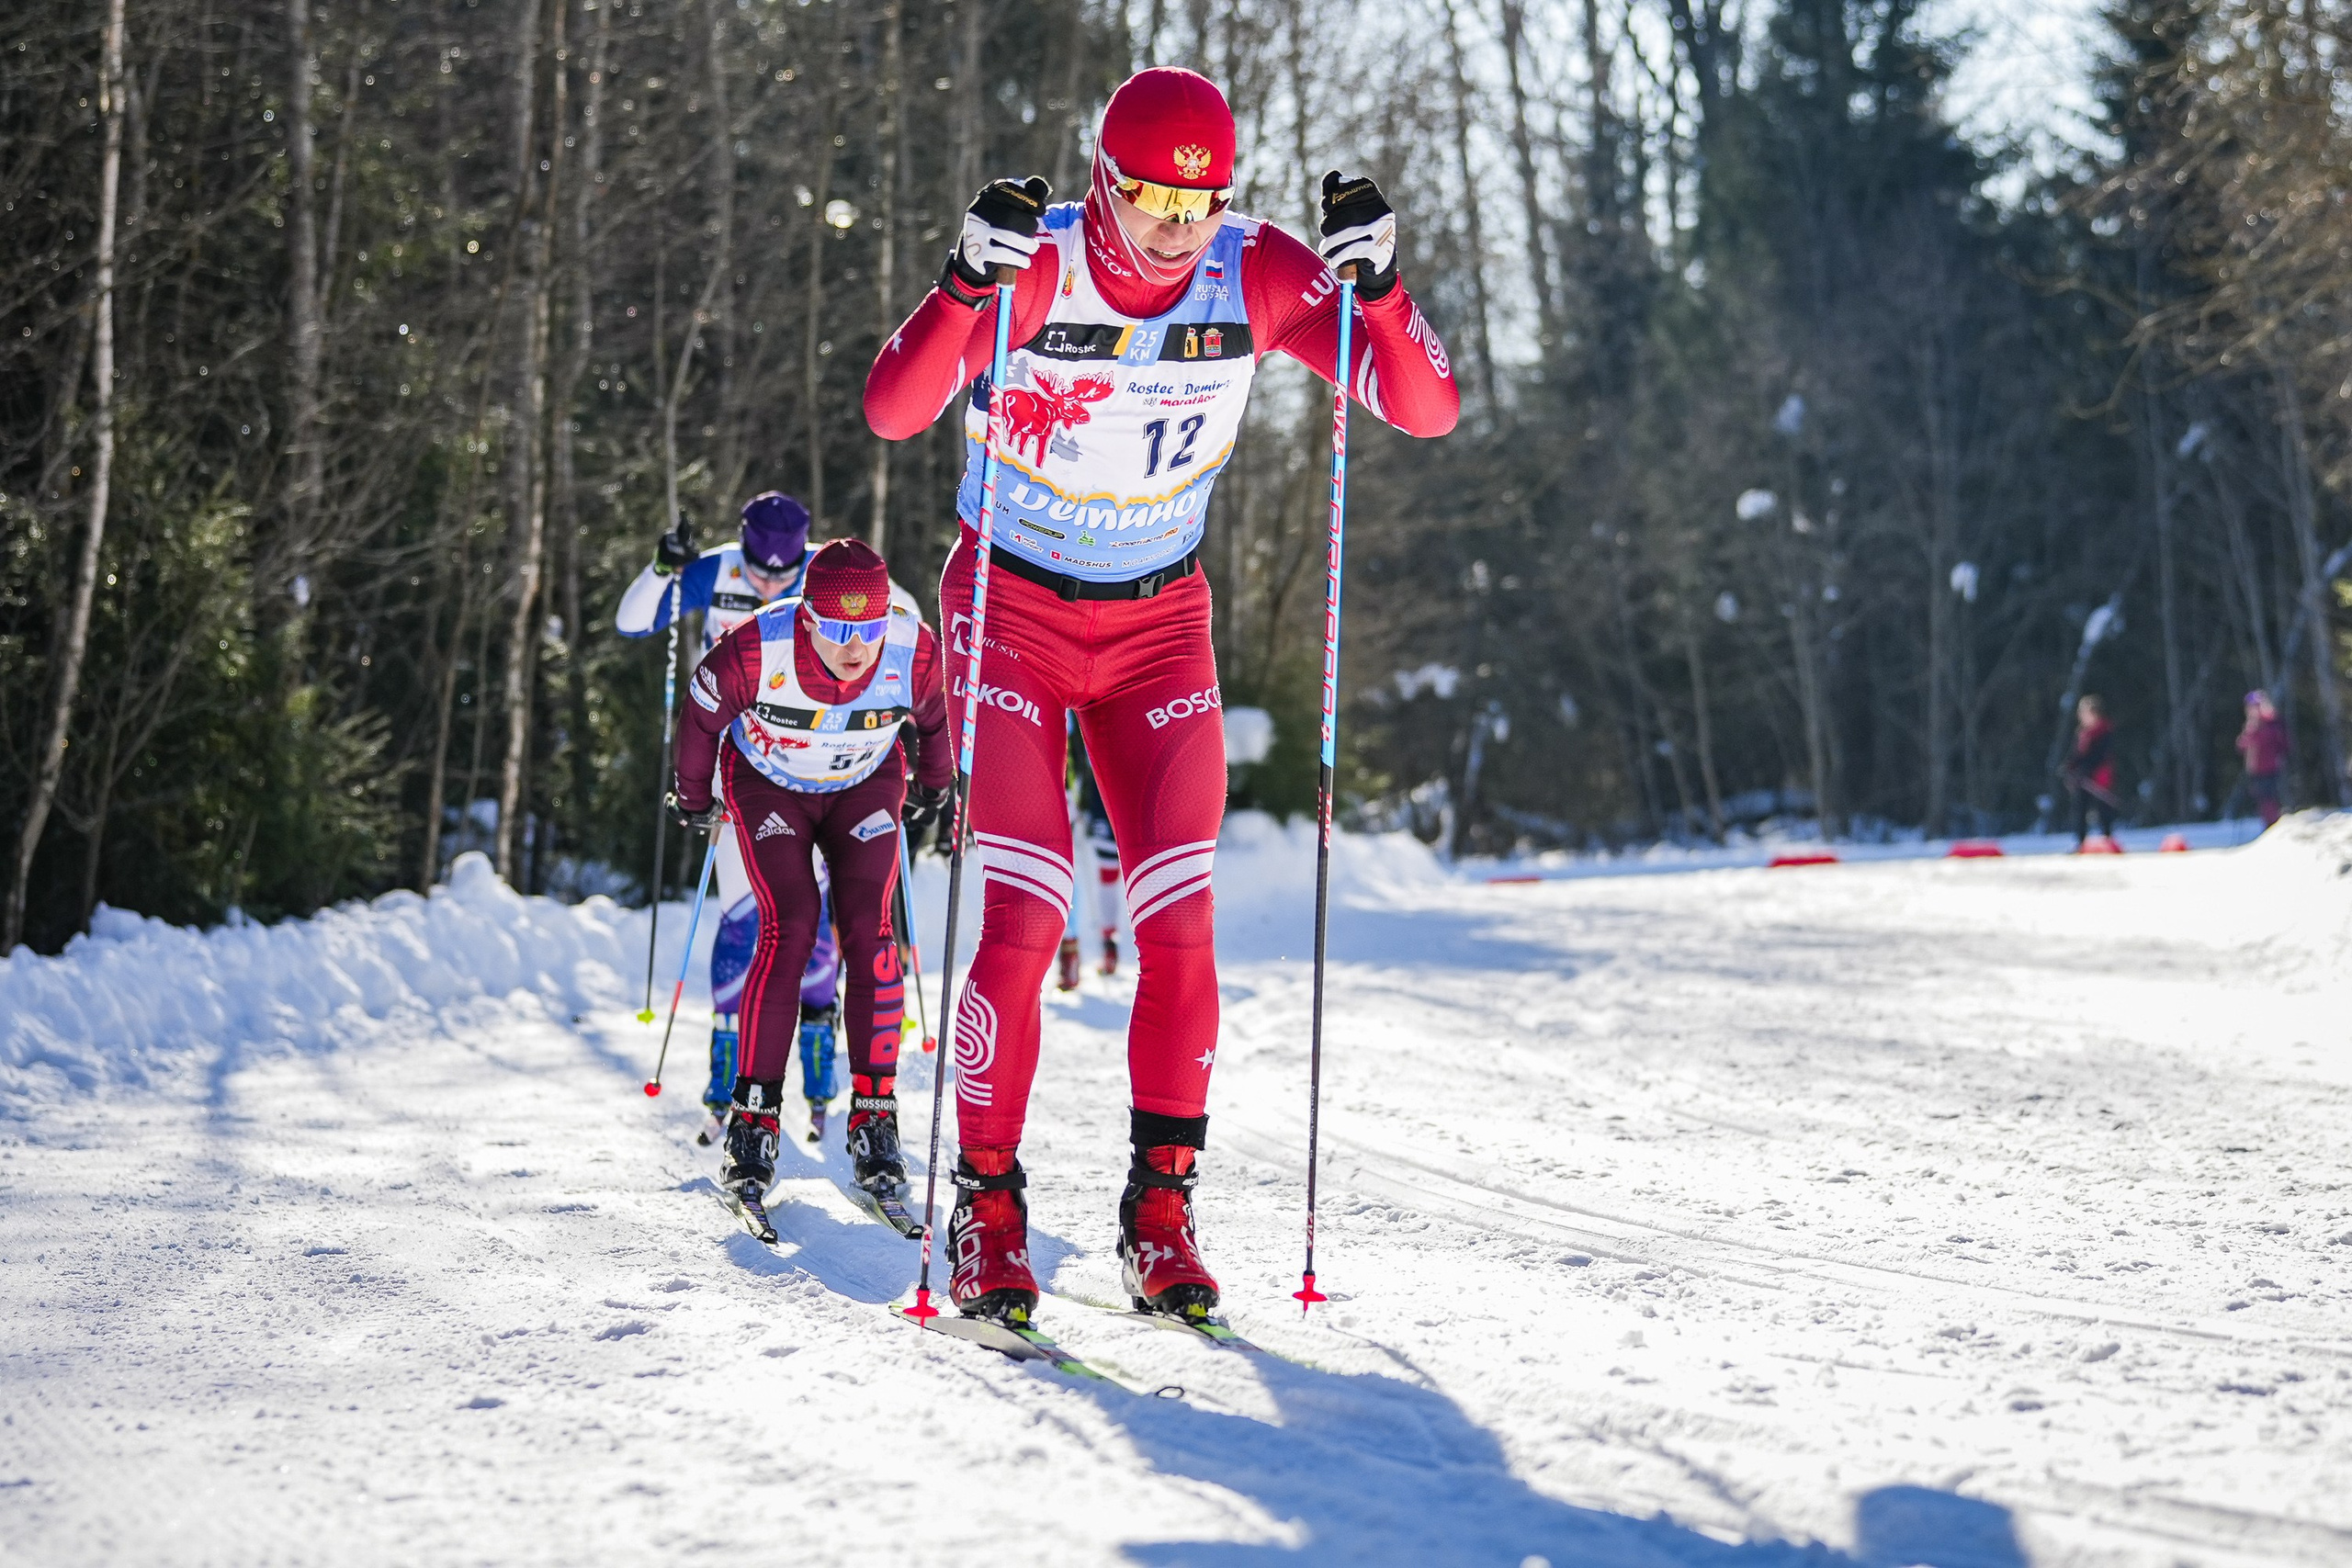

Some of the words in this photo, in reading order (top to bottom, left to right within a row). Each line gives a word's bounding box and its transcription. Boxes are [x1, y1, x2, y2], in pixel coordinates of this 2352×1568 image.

[1135, 331, 1159, 347] 25
[1129, 347, 1151, 361] KM
[1126, 382, 1174, 395] Rostec
[1142, 412, 1207, 479] 12
[1064, 557, 1112, 568] MADSHUS
[982, 637, 1022, 662] RUSAL
[770, 716, 798, 727] Rostec
[826, 712, 842, 724] 25
[755, 825, 797, 841] adidas
